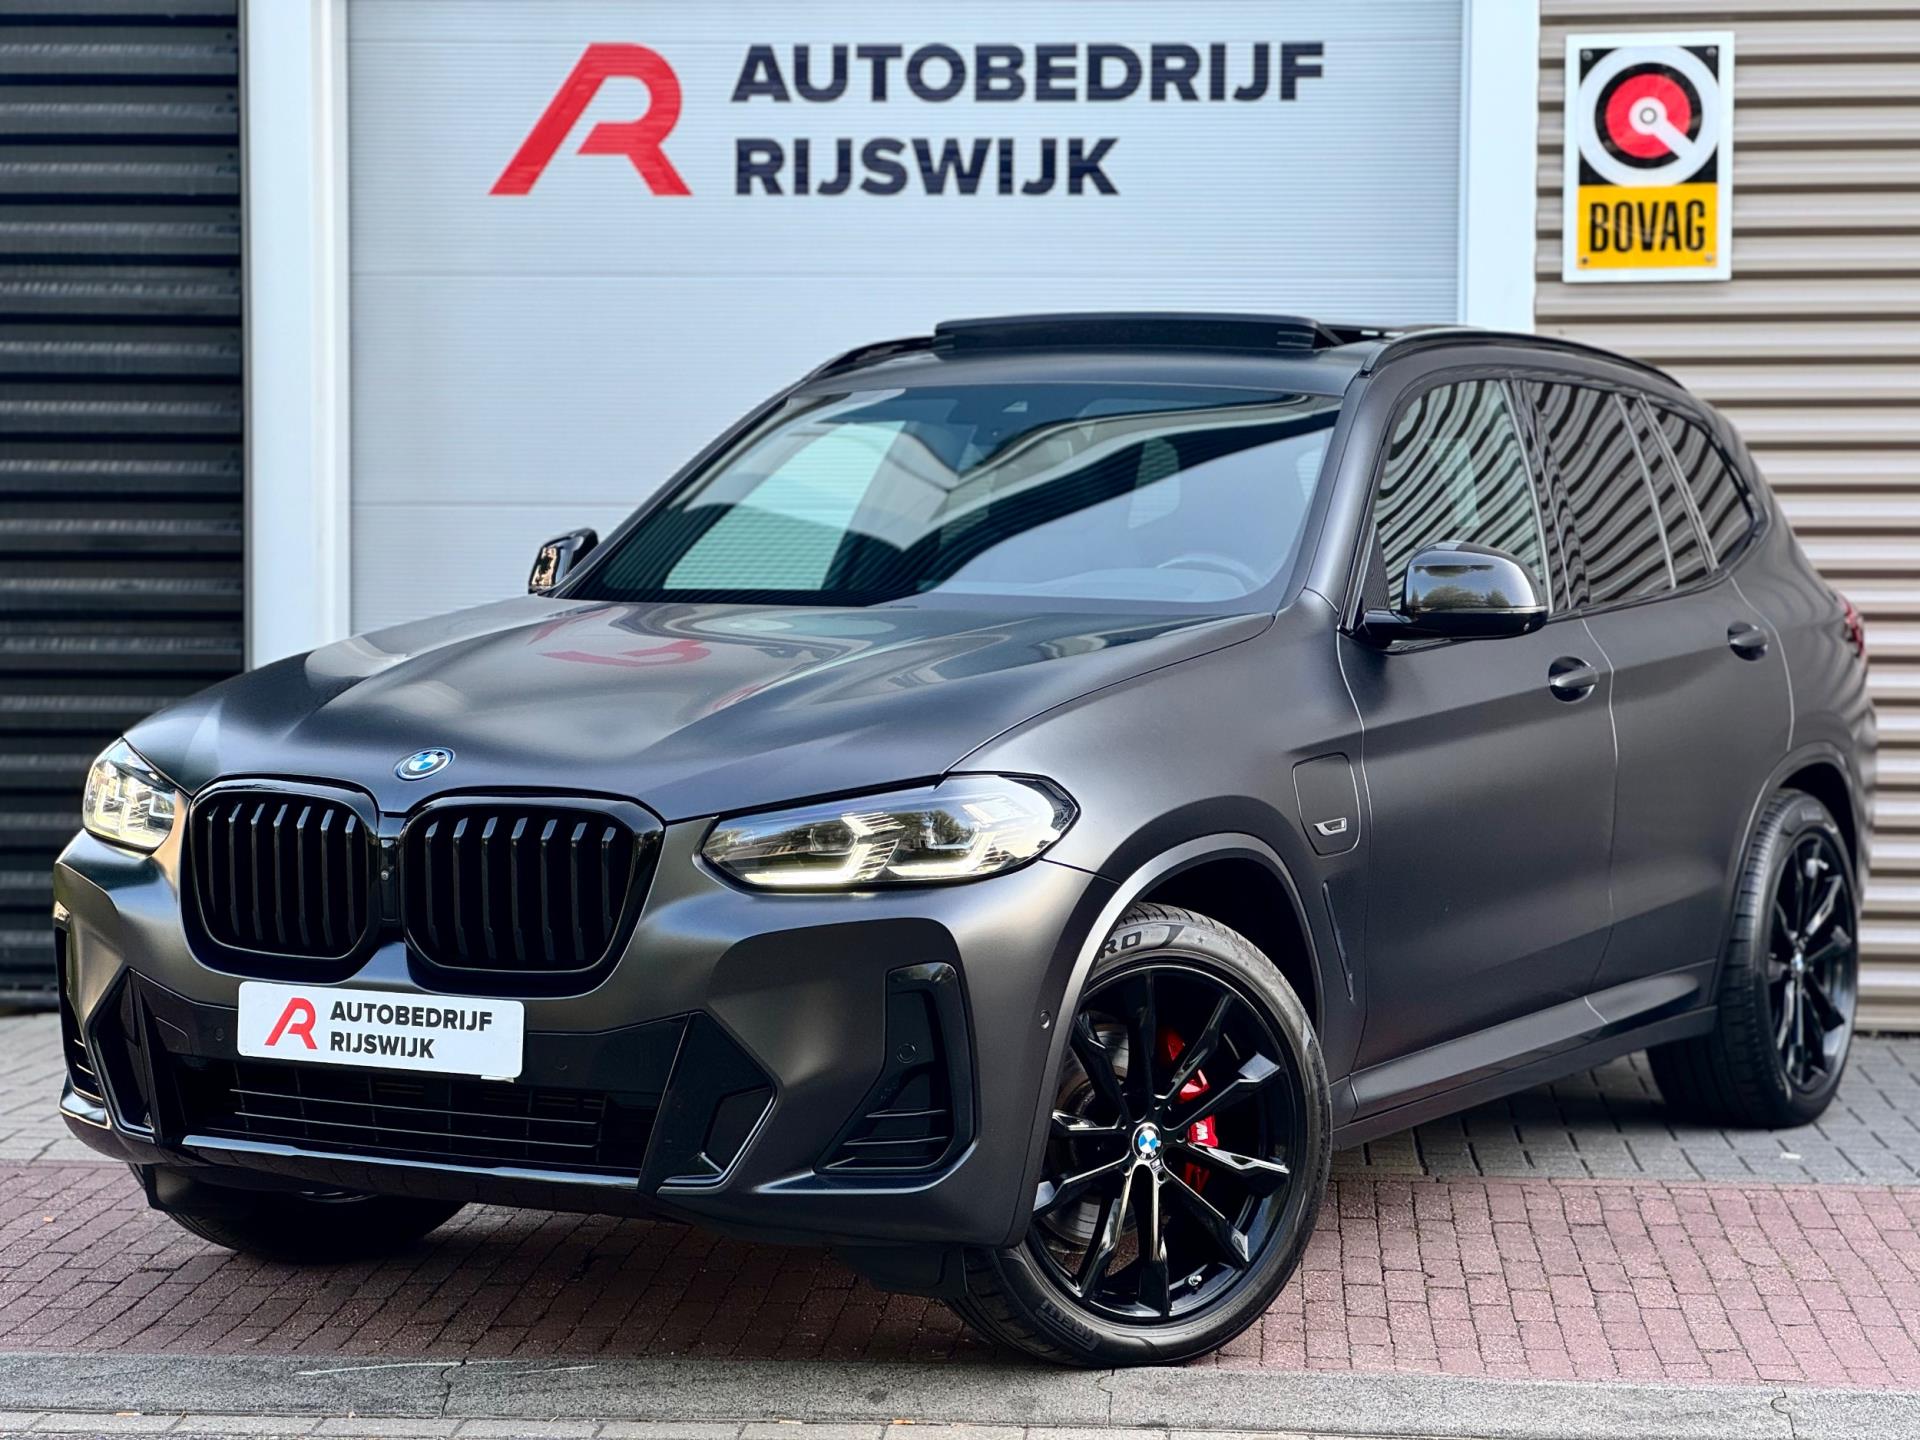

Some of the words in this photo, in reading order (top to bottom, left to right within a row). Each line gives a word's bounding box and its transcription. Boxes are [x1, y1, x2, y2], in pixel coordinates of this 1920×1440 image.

[731, 42, 1325, 103] AUTOBEDRIJF
[735, 137, 1119, 196] RIJSWIJK
[1590, 199, 1706, 254] BOVAG
[330, 1001, 493, 1031] AUTOBEDRIJF
[330, 1032, 434, 1059] RIJSWIJK
